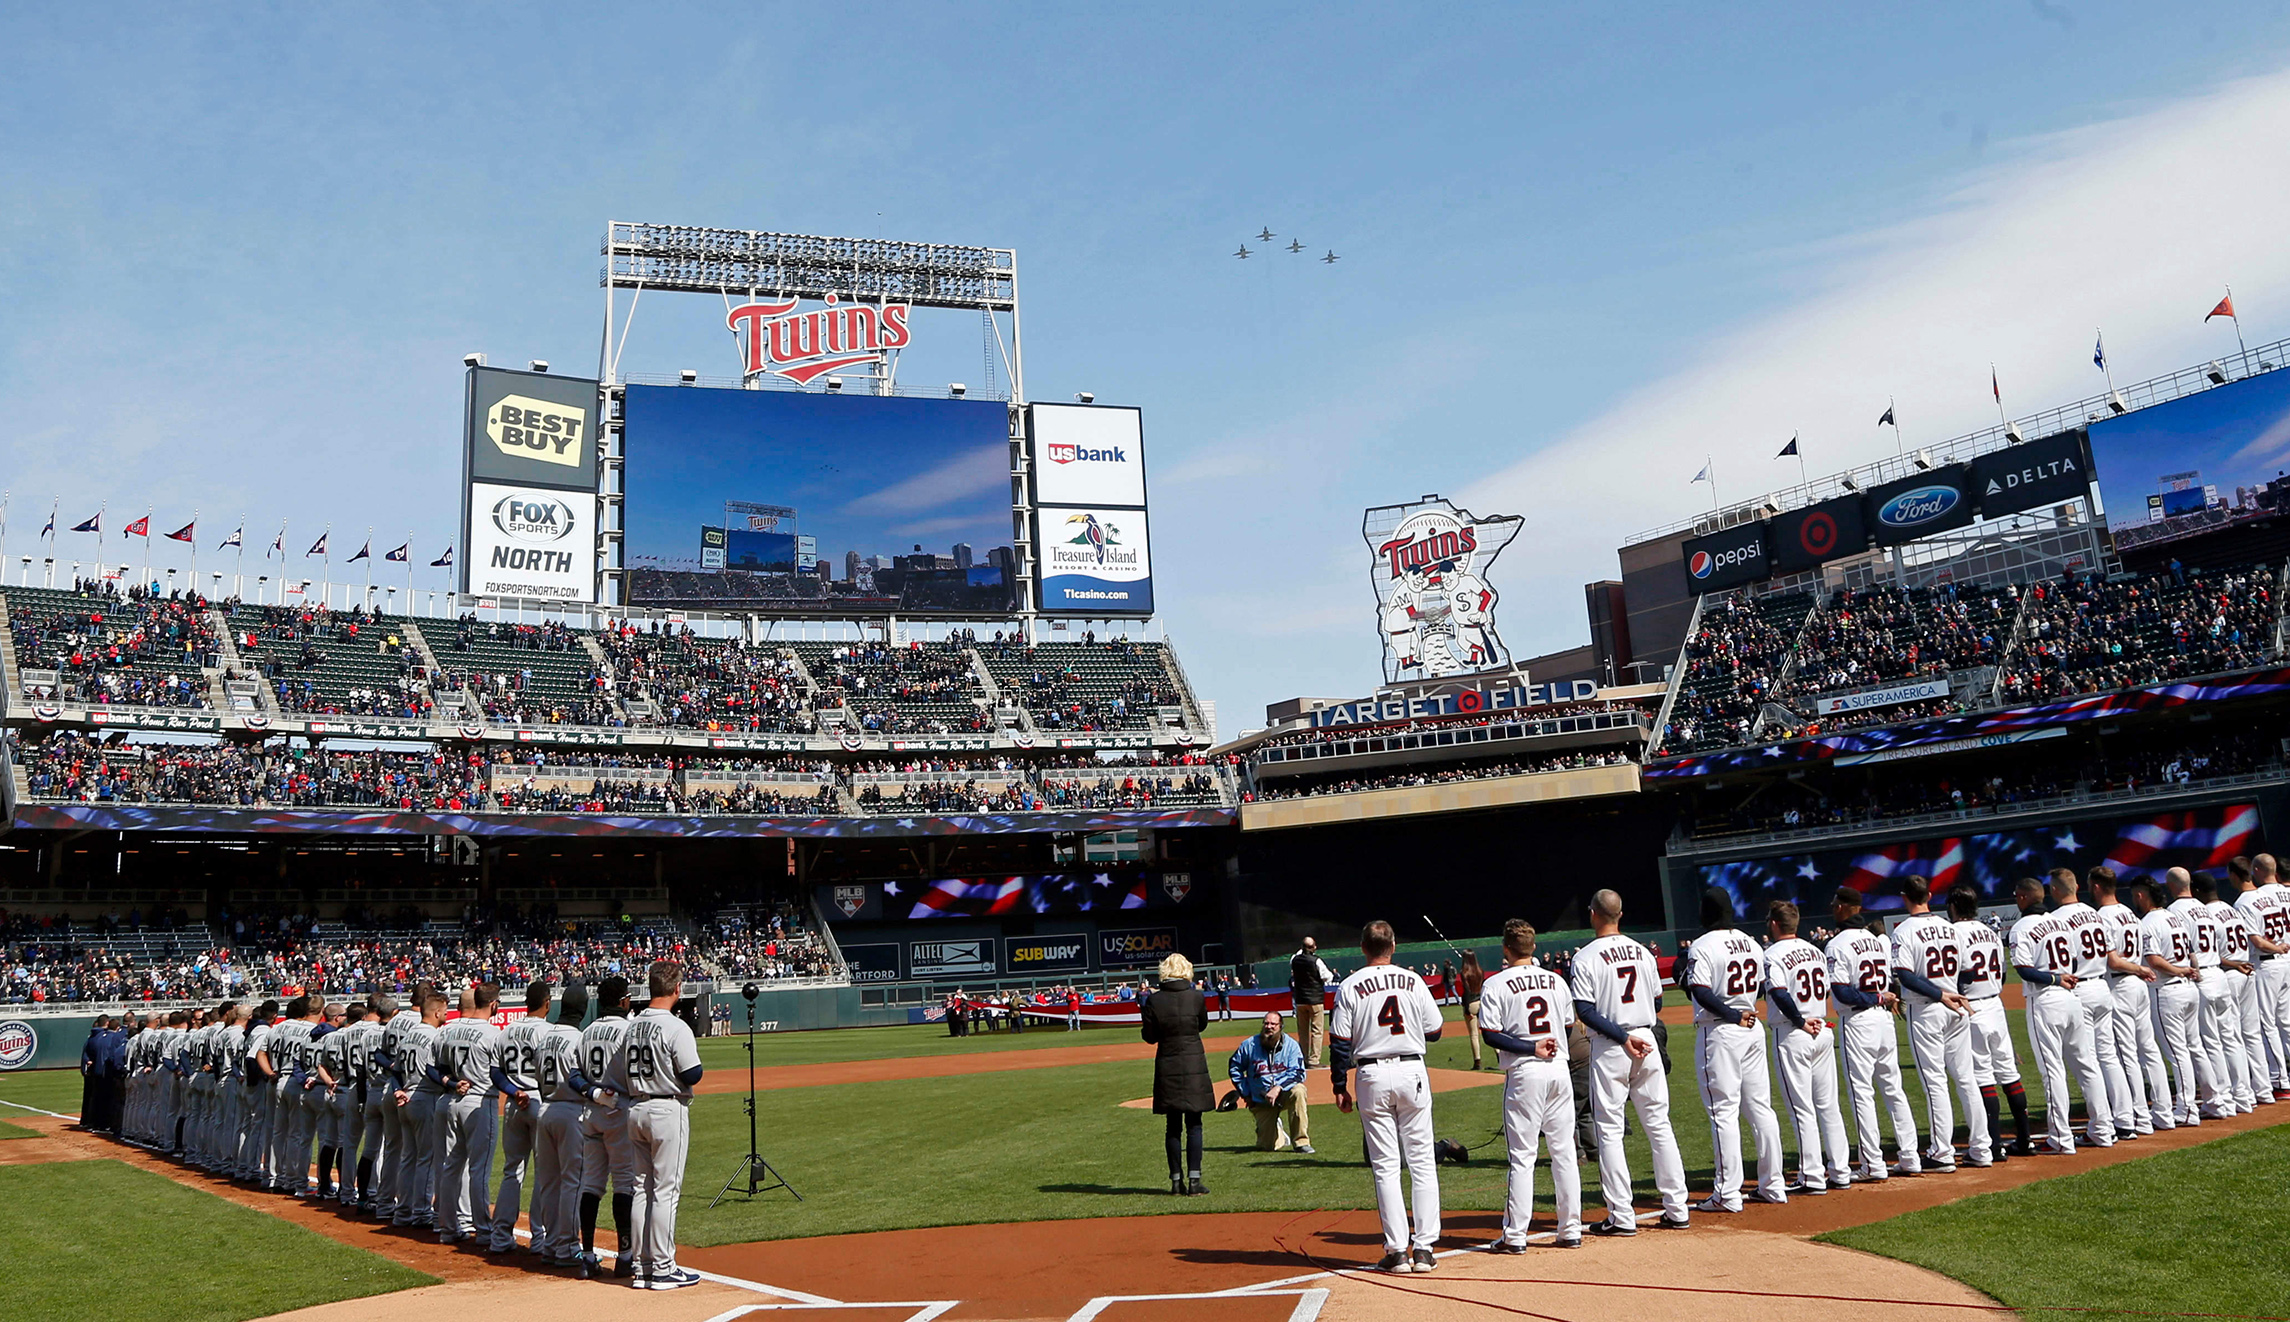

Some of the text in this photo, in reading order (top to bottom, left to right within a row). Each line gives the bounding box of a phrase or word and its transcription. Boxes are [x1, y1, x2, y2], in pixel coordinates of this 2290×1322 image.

[726, 292, 911, 378] Twins
[500, 405, 581, 437] BEST
[501, 425, 574, 455] BUY
[2006, 458, 2076, 488] DELTA
[509, 501, 557, 525] FOX
[747, 514, 779, 530] Twins
[1895, 492, 1943, 524] Ford
[508, 522, 558, 535] SPORTS
[491, 545, 573, 573] NORTH
[1050, 546, 1137, 564] Treasure Island
[1379, 526, 1477, 581] Twins
[1714, 539, 1761, 572] pepsi
[485, 581, 579, 598] FOXSPORTSNORTH.COM
[1063, 588, 1129, 600] TIcasino.com
[1309, 679, 1598, 727] TARGET FIELD
[1852, 686, 1936, 708] SUPERAMERICA
[140, 715, 165, 726] Home
[167, 716, 186, 727] Run
[188, 718, 214, 729] Porch
[353, 724, 376, 735] Home
[378, 725, 396, 736] Run
[397, 727, 420, 737] Porch
[1882, 733, 2012, 760] TREASURE ISLAND COVE
[837, 888, 863, 897] MLB
[1165, 875, 1188, 884] MLB
[1850, 938, 1885, 955] BUXTON
[1916, 926, 1956, 944] KEPLER
[2080, 928, 2107, 960] 99
[2198, 925, 2217, 953] 57
[2226, 924, 2248, 954] 56
[847, 962, 860, 970] HE
[914, 944, 943, 960] ALTEC
[1013, 944, 1081, 963] SUBWAY
[1599, 945, 1643, 965] MAUER
[1925, 945, 1958, 978] 26
[1971, 949, 2001, 982] 24
[2046, 936, 2071, 970] 16
[849, 970, 896, 980] ARTFORD
[1353, 974, 1415, 1000] MOLITOR
[1506, 974, 1556, 994] DOZIER
[1617, 965, 1637, 1004] 7
[1727, 958, 1758, 996] 22
[1796, 968, 1825, 1002] 36
[1859, 959, 1887, 992] 25
[760, 1021, 779, 1031] 377
[1378, 995, 1405, 1035] 4
[1526, 996, 1551, 1035] 2
[508, 1026, 535, 1042] CANO
[452, 1046, 470, 1072] 17
[505, 1046, 535, 1074] 22
[544, 1056, 557, 1085] 2
[590, 1046, 604, 1078] 9
[627, 1045, 655, 1078] 29
